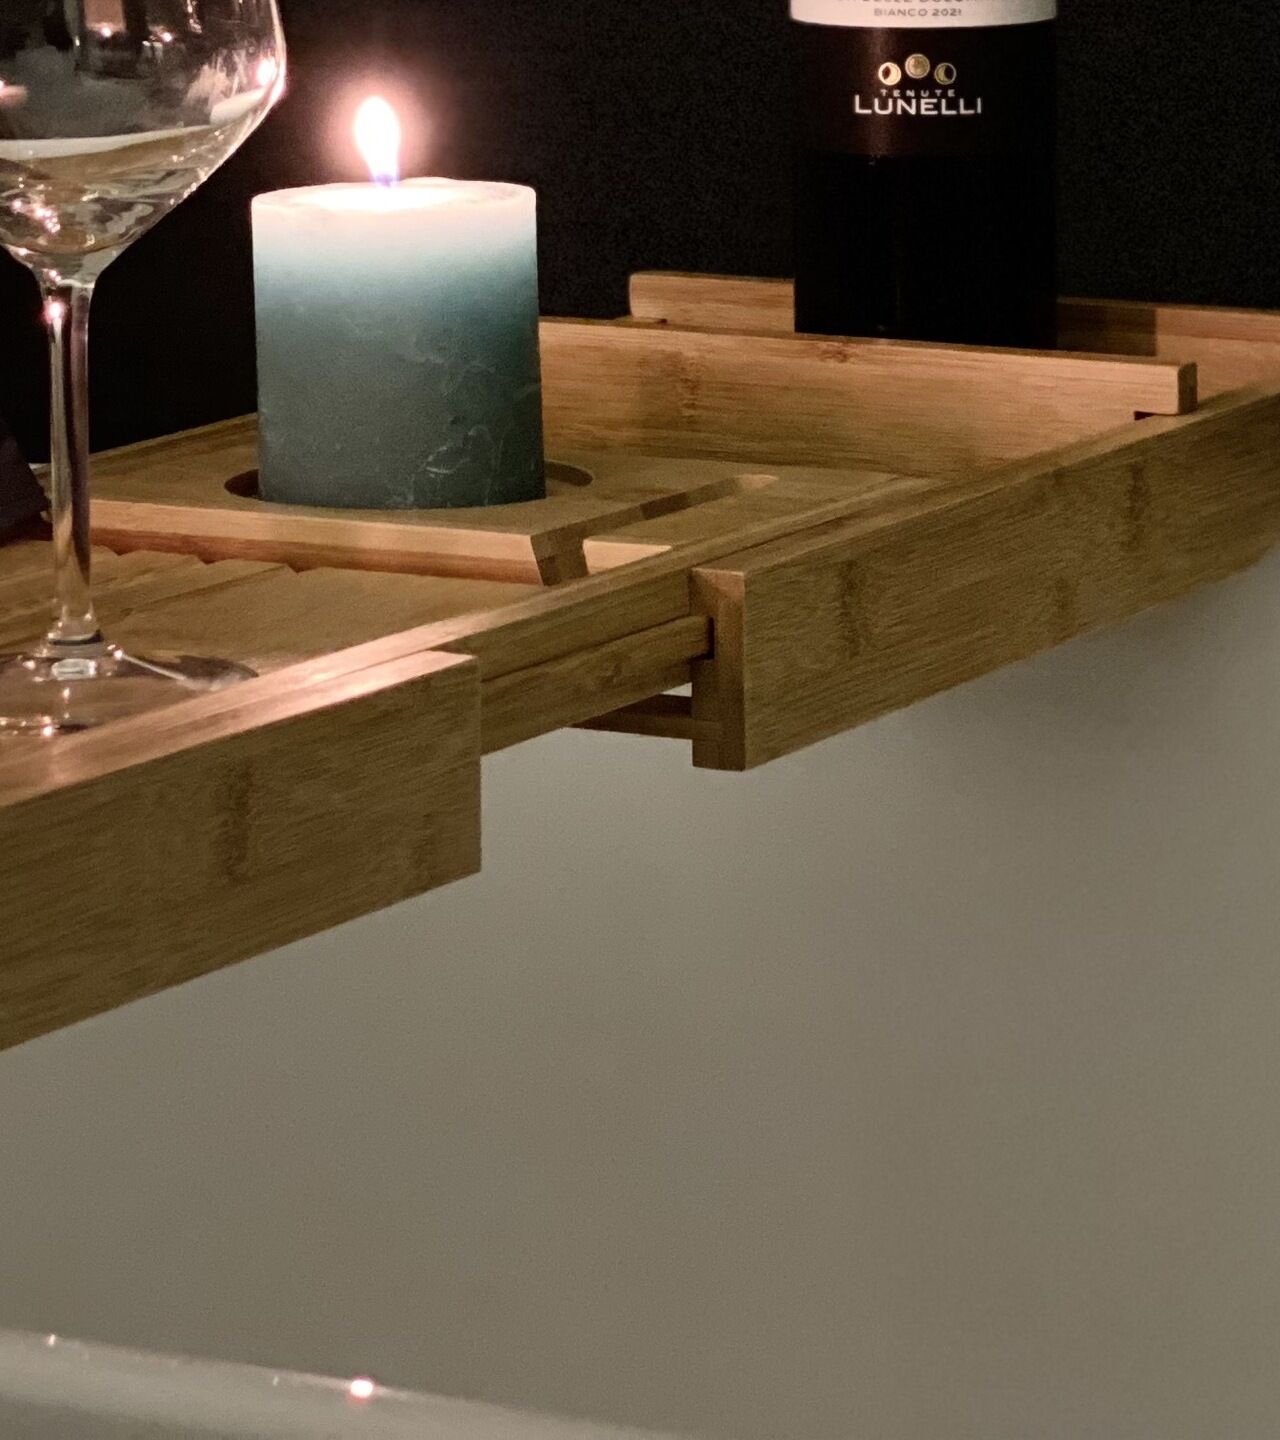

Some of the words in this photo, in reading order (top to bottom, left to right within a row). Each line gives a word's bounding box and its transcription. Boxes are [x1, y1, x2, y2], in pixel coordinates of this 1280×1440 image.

[874, 7, 928, 17] BIANCO
[932, 7, 962, 17] 2021
[880, 88, 956, 97] TENUTE
[854, 94, 982, 115] LUNELLI
